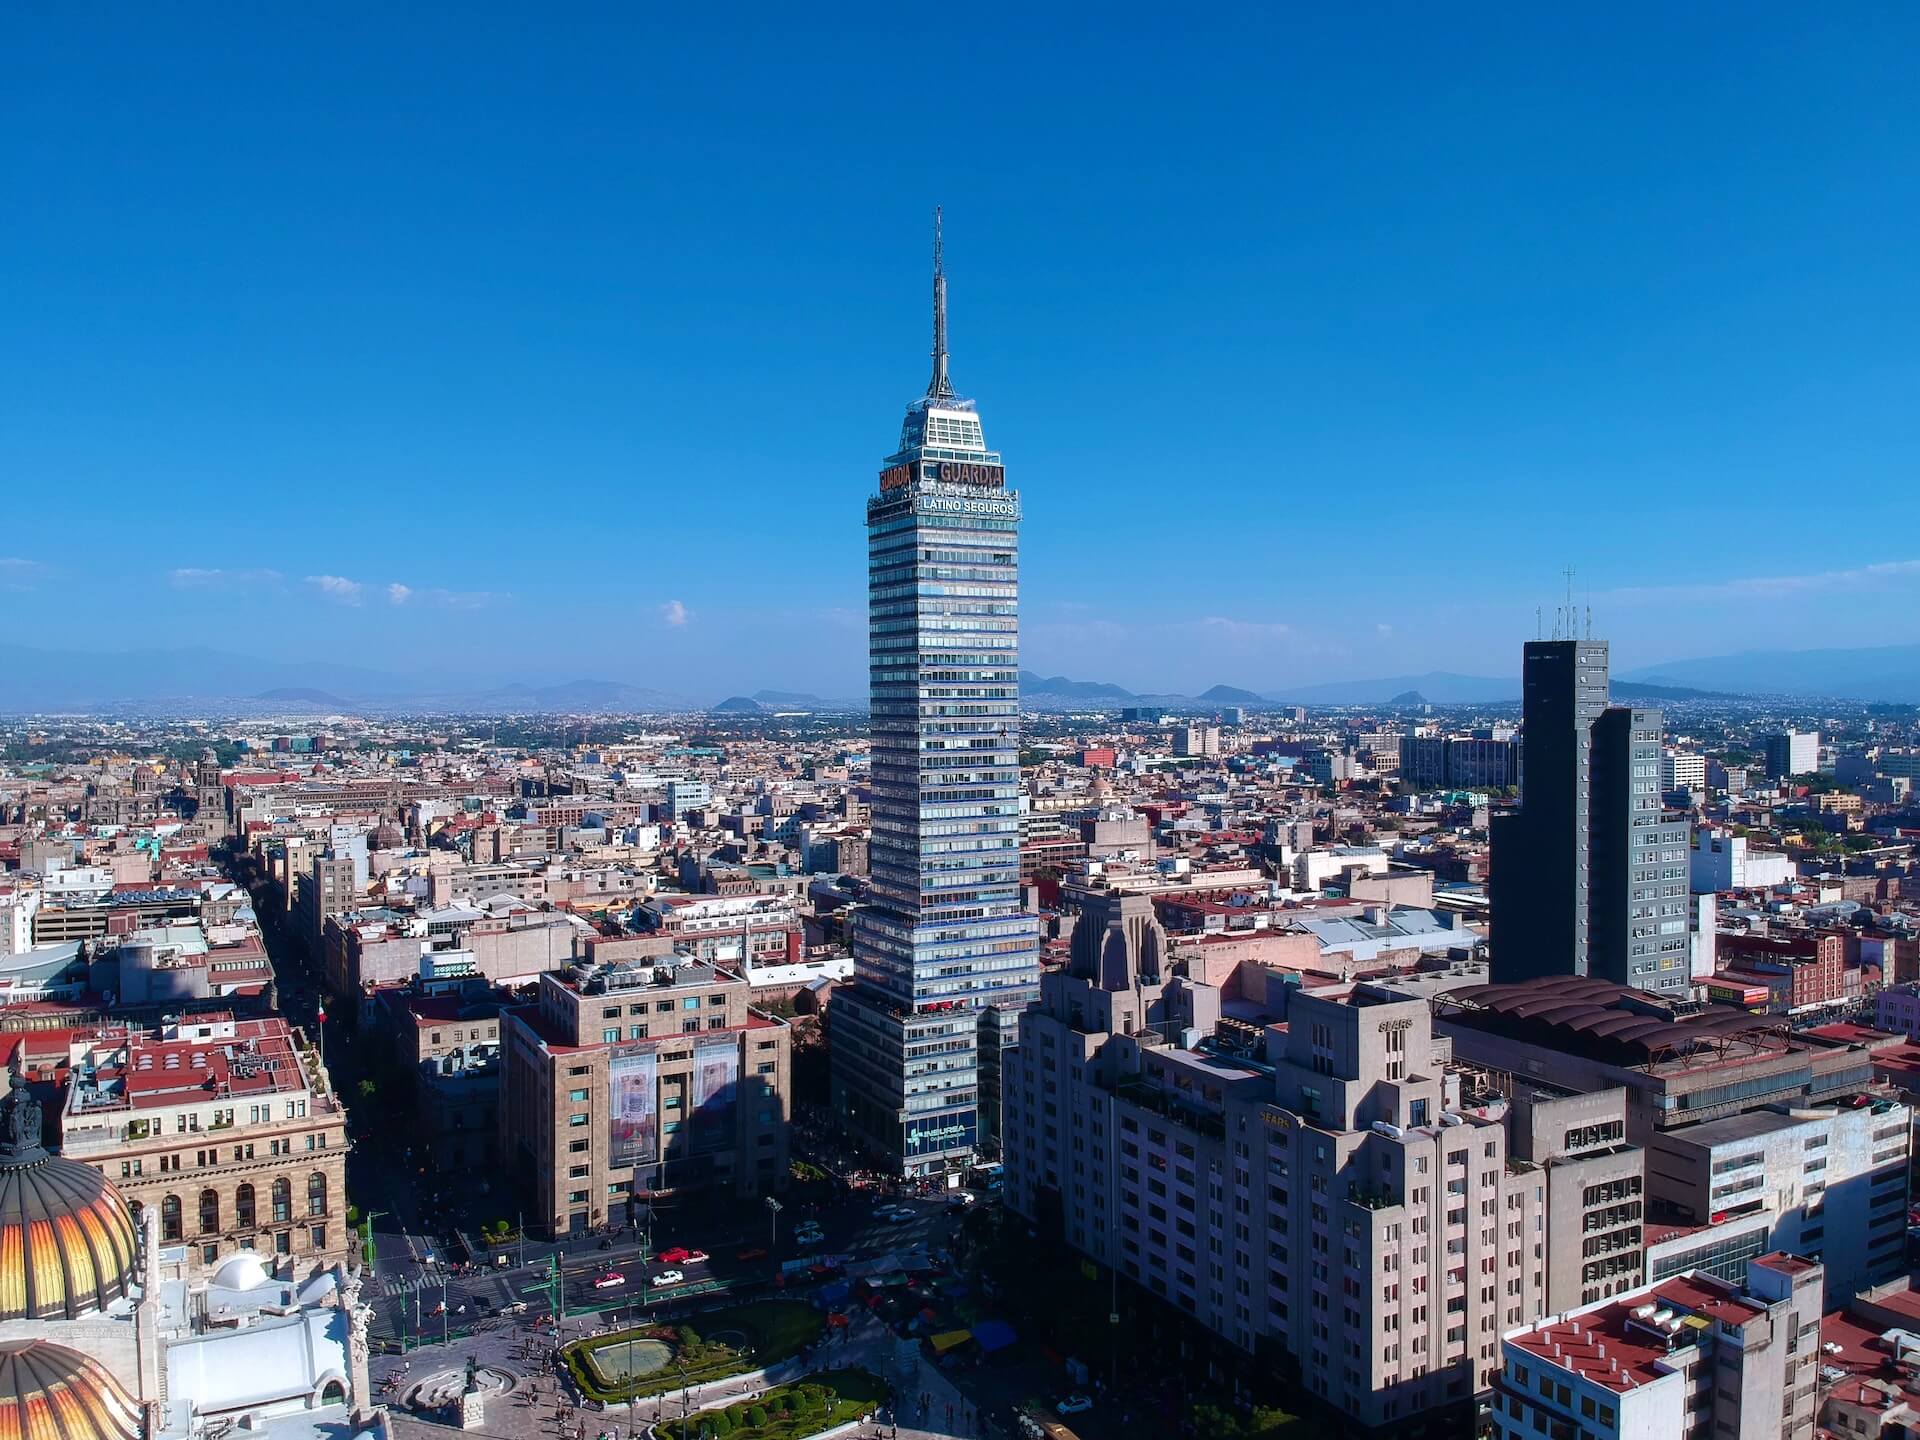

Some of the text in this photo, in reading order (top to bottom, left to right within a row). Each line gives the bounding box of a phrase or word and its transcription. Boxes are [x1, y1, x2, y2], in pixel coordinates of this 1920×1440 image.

[880, 464, 911, 490] GUARDIA
[940, 462, 1003, 485] GUARDIA
[923, 498, 1014, 515] LATINO SEGUROS
[1378, 1018, 1412, 1032] SEARS
[1259, 1111, 1290, 1129] SEARS
